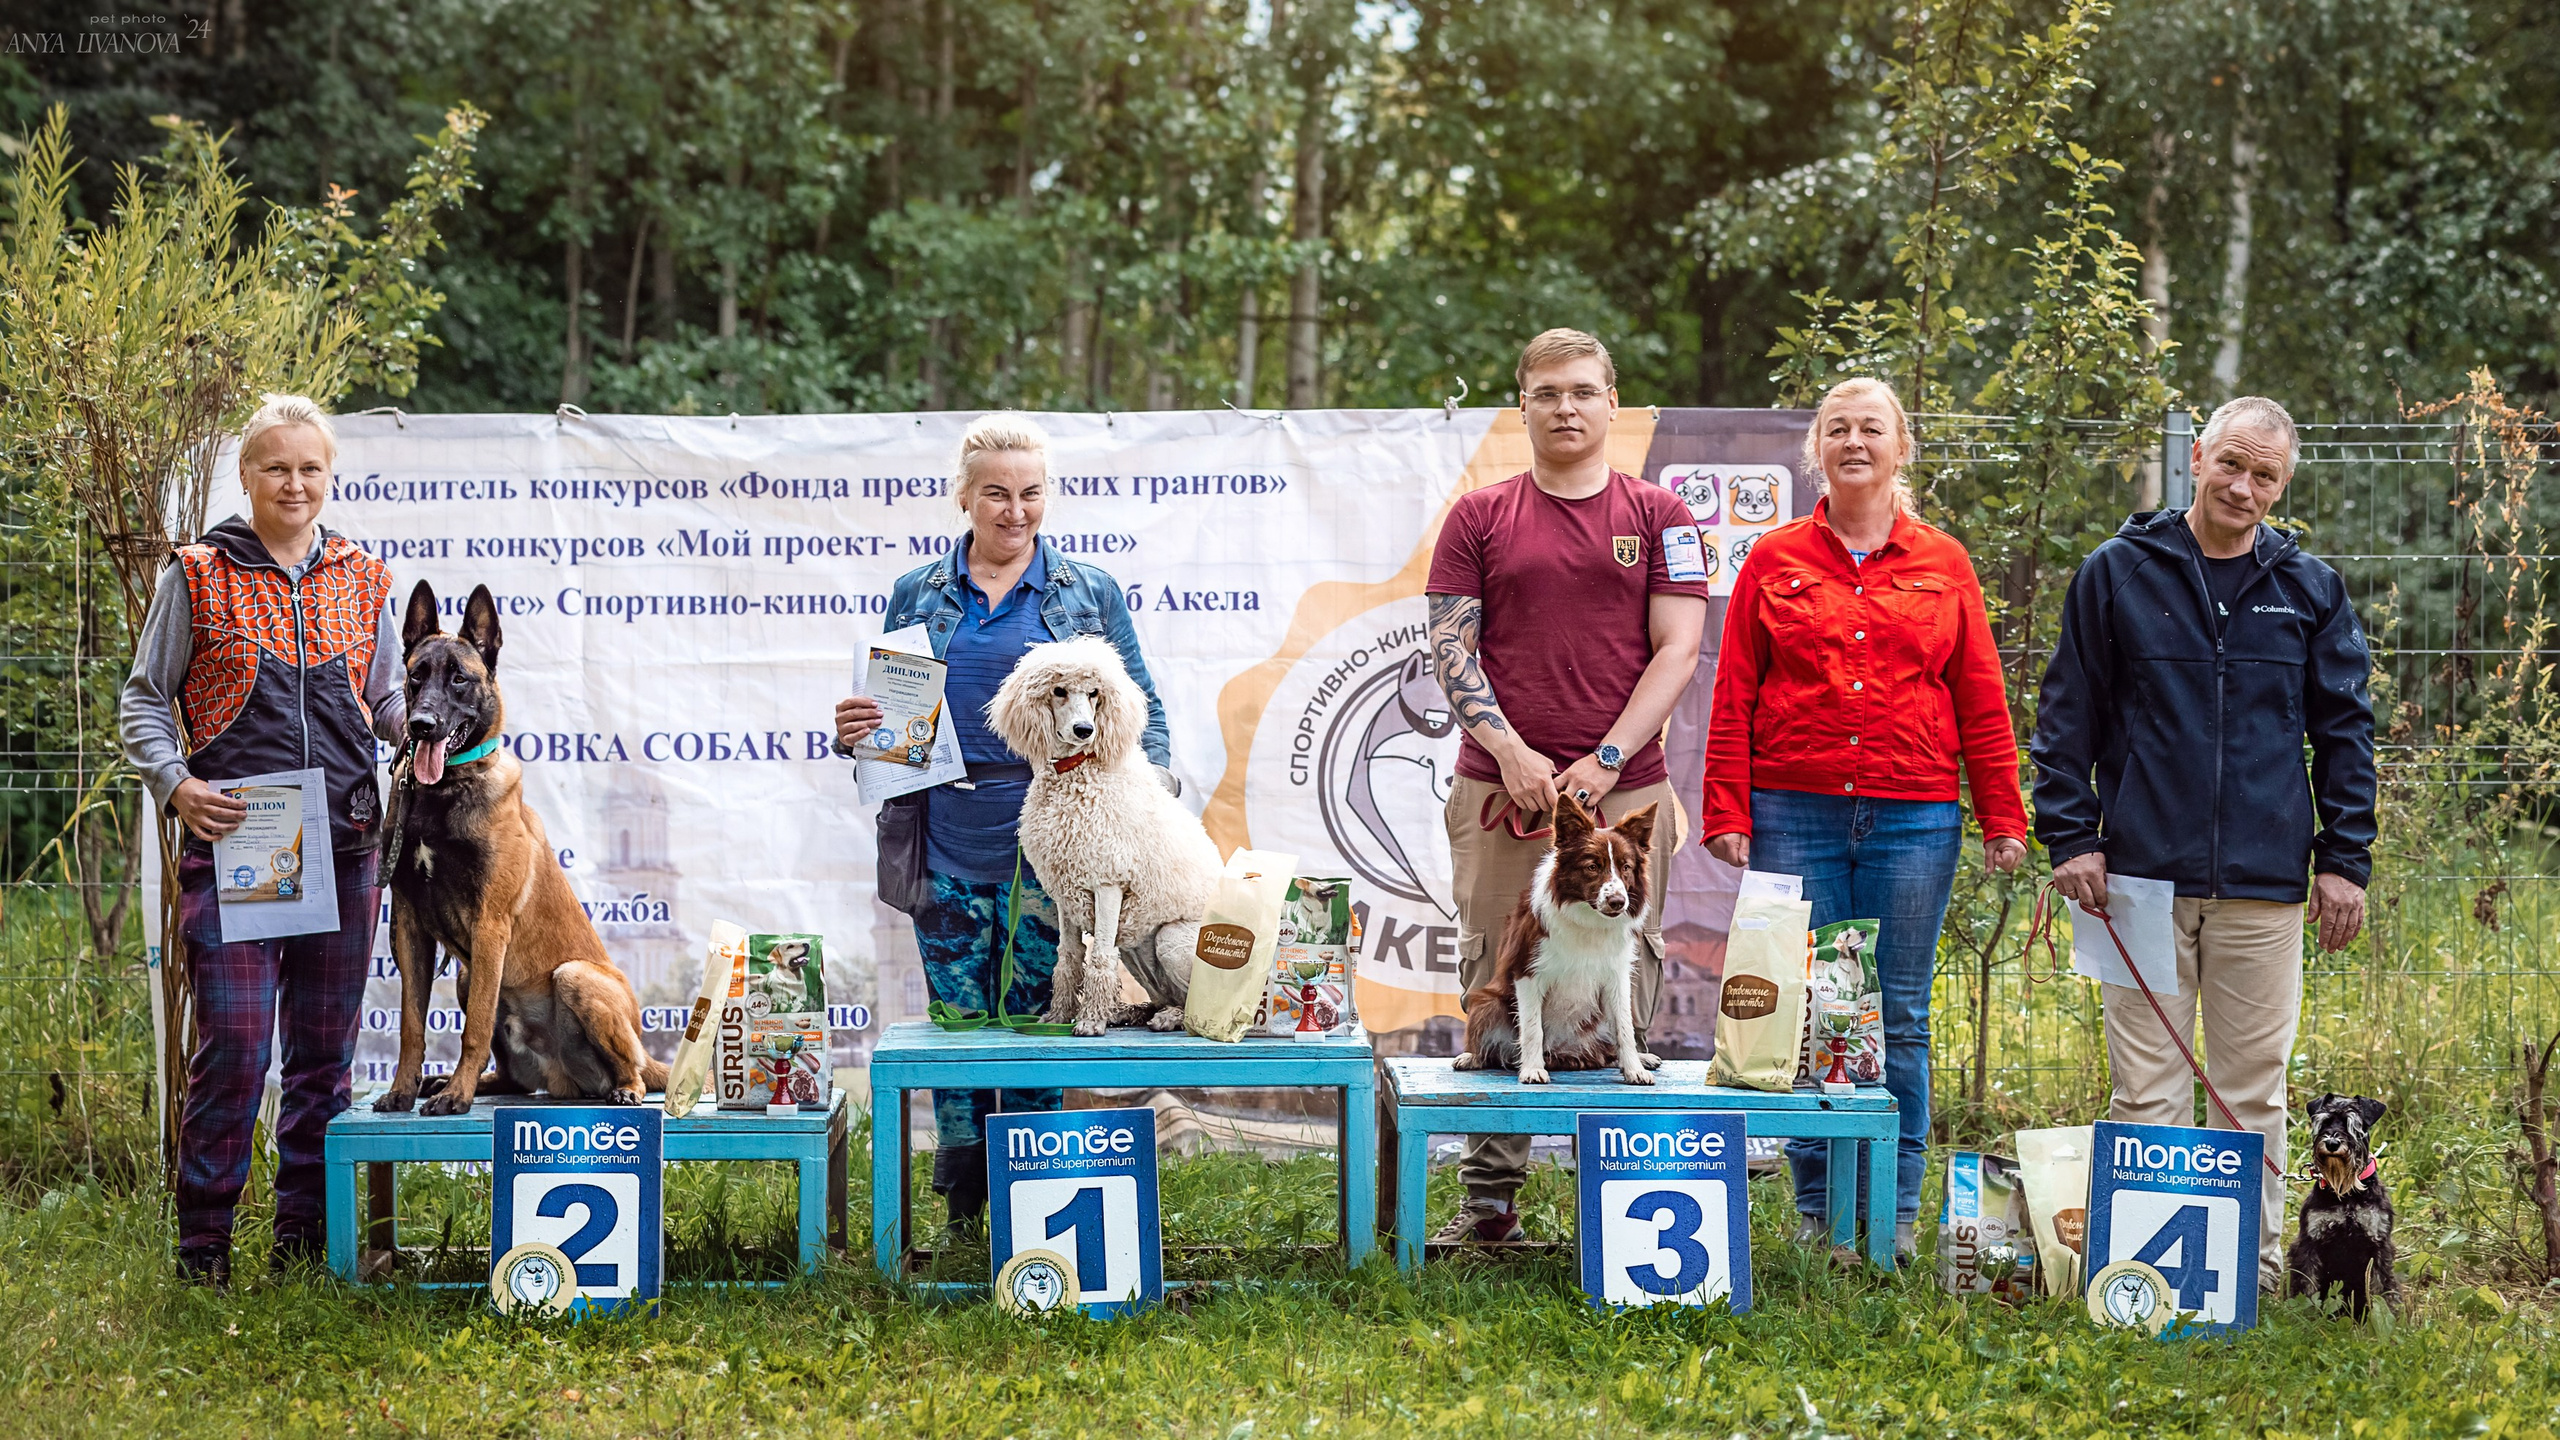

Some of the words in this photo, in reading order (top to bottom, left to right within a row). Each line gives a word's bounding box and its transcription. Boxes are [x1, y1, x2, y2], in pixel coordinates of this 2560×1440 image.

[530, 478, 709, 507] конкурсов
[719, 471, 850, 502] «Фонда
[1131, 474, 1288, 504] грантов»
[466, 536, 646, 566] конкурсов
[656, 528, 752, 558] «Мой
[762, 534, 897, 565] проект-
[556, 586, 888, 623] Спортивно-киноло
[1153, 583, 1260, 613] Акела
[2261, 605, 2296, 615] Columbia
[882, 664, 930, 681] ДИПЛОМ
[1290, 622, 1428, 786] СПОРТИВНО-КИН
[642, 730, 792, 763] СОБАК
[246, 801, 286, 811] ИПЛОМ
[580, 893, 671, 924] ужба
[722, 1006, 744, 1100] SIRIUS
[514, 1153, 554, 1163] Natural
[557, 1153, 640, 1165] Superpremium
[1009, 1159, 1049, 1171] Natural
[1052, 1156, 1136, 1170] Superpremium
[1600, 1160, 1640, 1170] Natural
[1643, 1160, 1726, 1172] Superpremium
[2112, 1169, 2154, 1182] Natural
[2156, 1172, 2241, 1188] Superpremium
[536, 1183, 619, 1287] 2
[1045, 1187, 1107, 1291] 1
[1625, 1190, 1710, 1296] 3
[2129, 1205, 2219, 1310] 4
